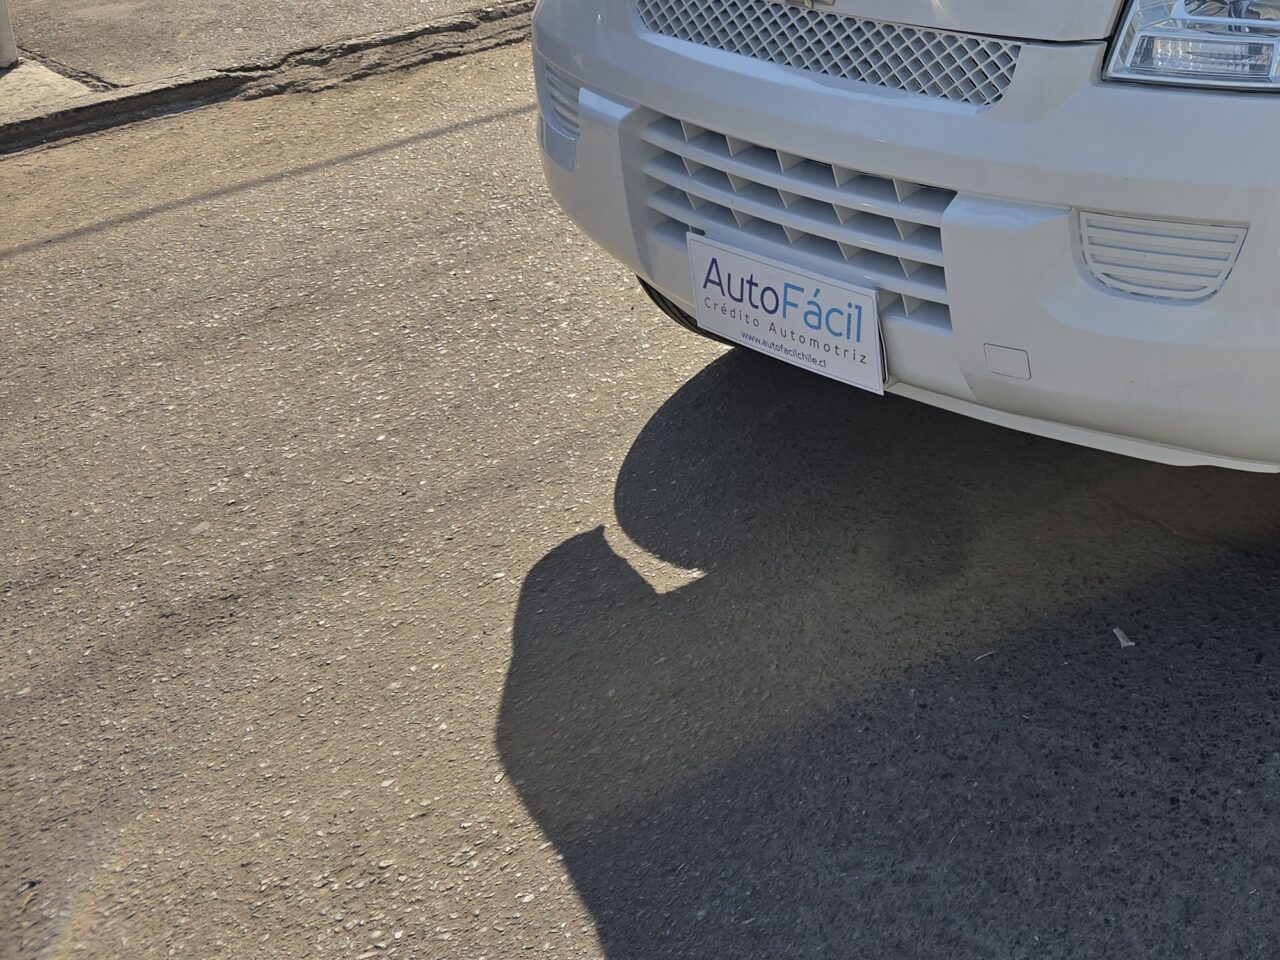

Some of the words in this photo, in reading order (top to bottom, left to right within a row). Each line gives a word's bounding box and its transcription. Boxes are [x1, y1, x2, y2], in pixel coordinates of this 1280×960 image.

[702, 256, 864, 343] AutoFácil
[703, 296, 761, 329] Crédito
[768, 321, 868, 365] Automotriz
[740, 330, 827, 369] www.autofacilchile.cl
